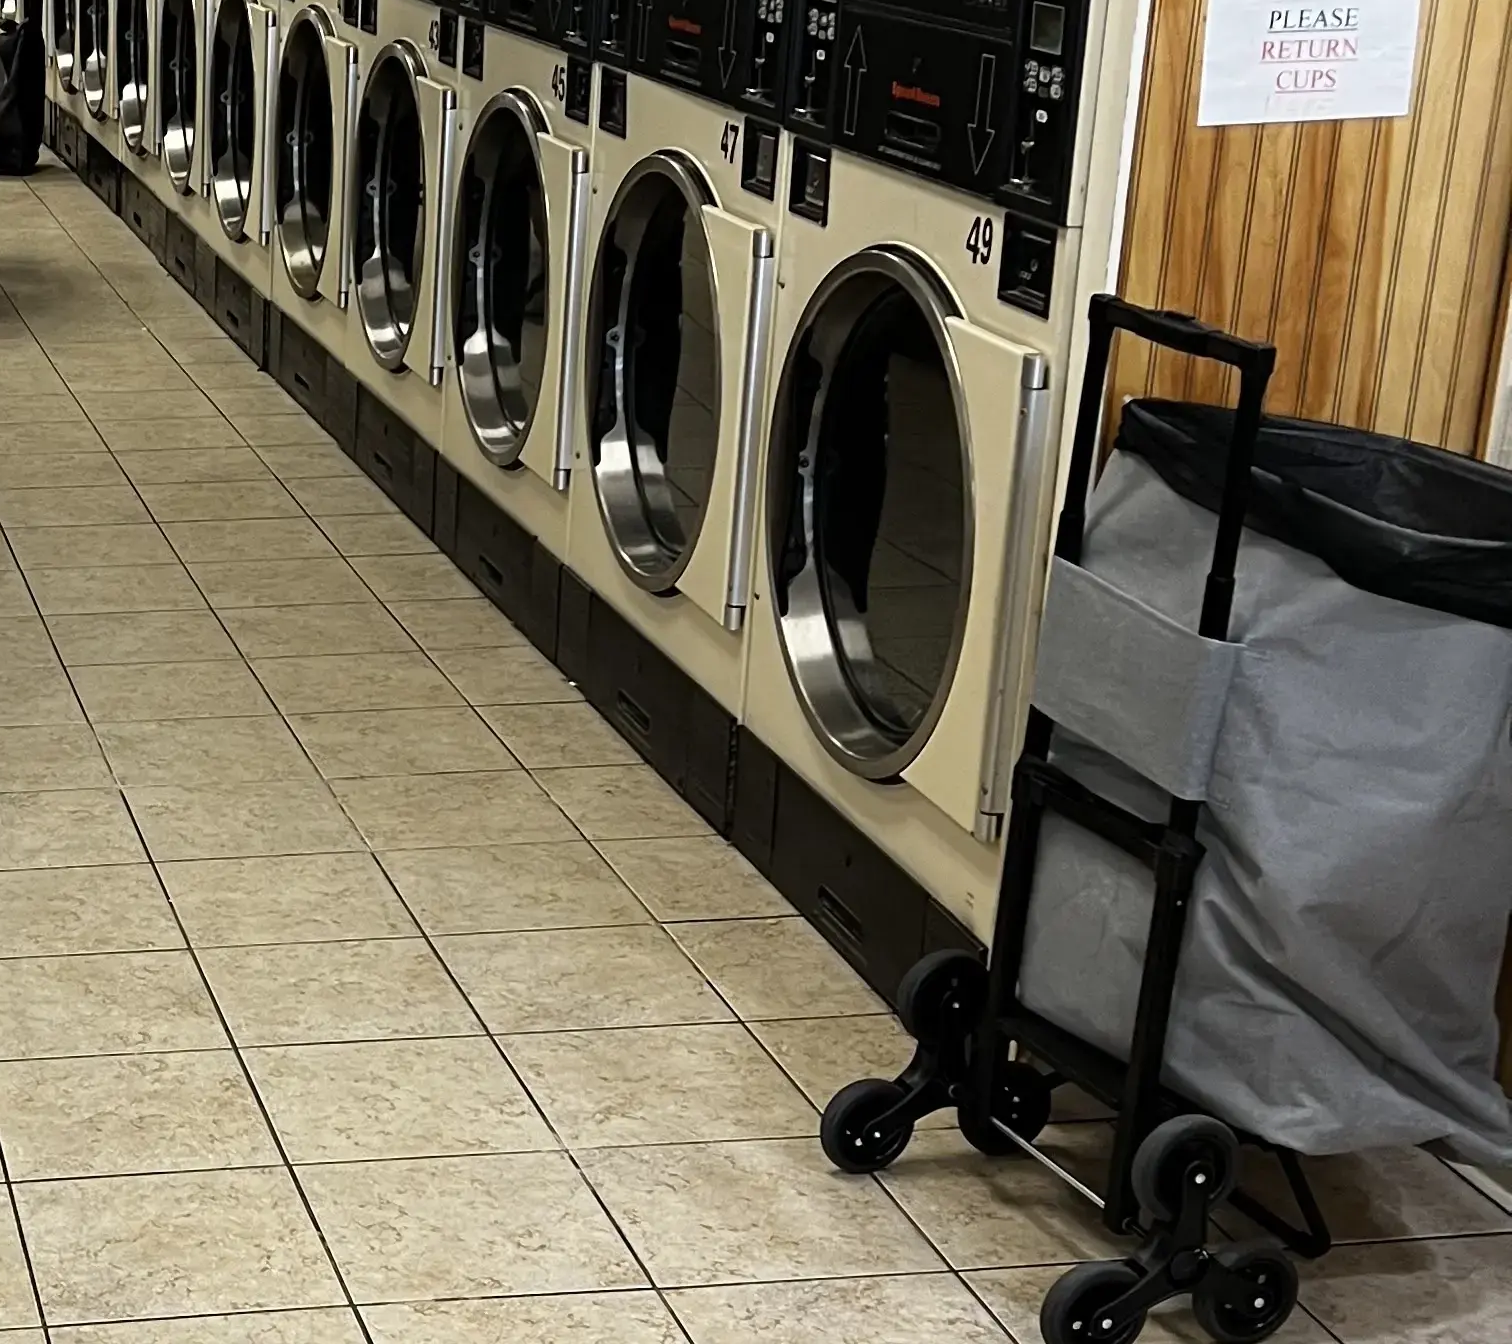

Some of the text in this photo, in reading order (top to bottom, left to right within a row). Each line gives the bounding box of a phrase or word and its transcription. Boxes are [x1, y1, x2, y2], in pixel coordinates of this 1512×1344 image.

[1268, 8, 1359, 29] PLEASE
[1261, 36, 1359, 60] RETURN
[552, 64, 565, 101] 45
[1276, 69, 1336, 90] CUPS
[721, 121, 739, 163] 47
[966, 216, 993, 264] 49
